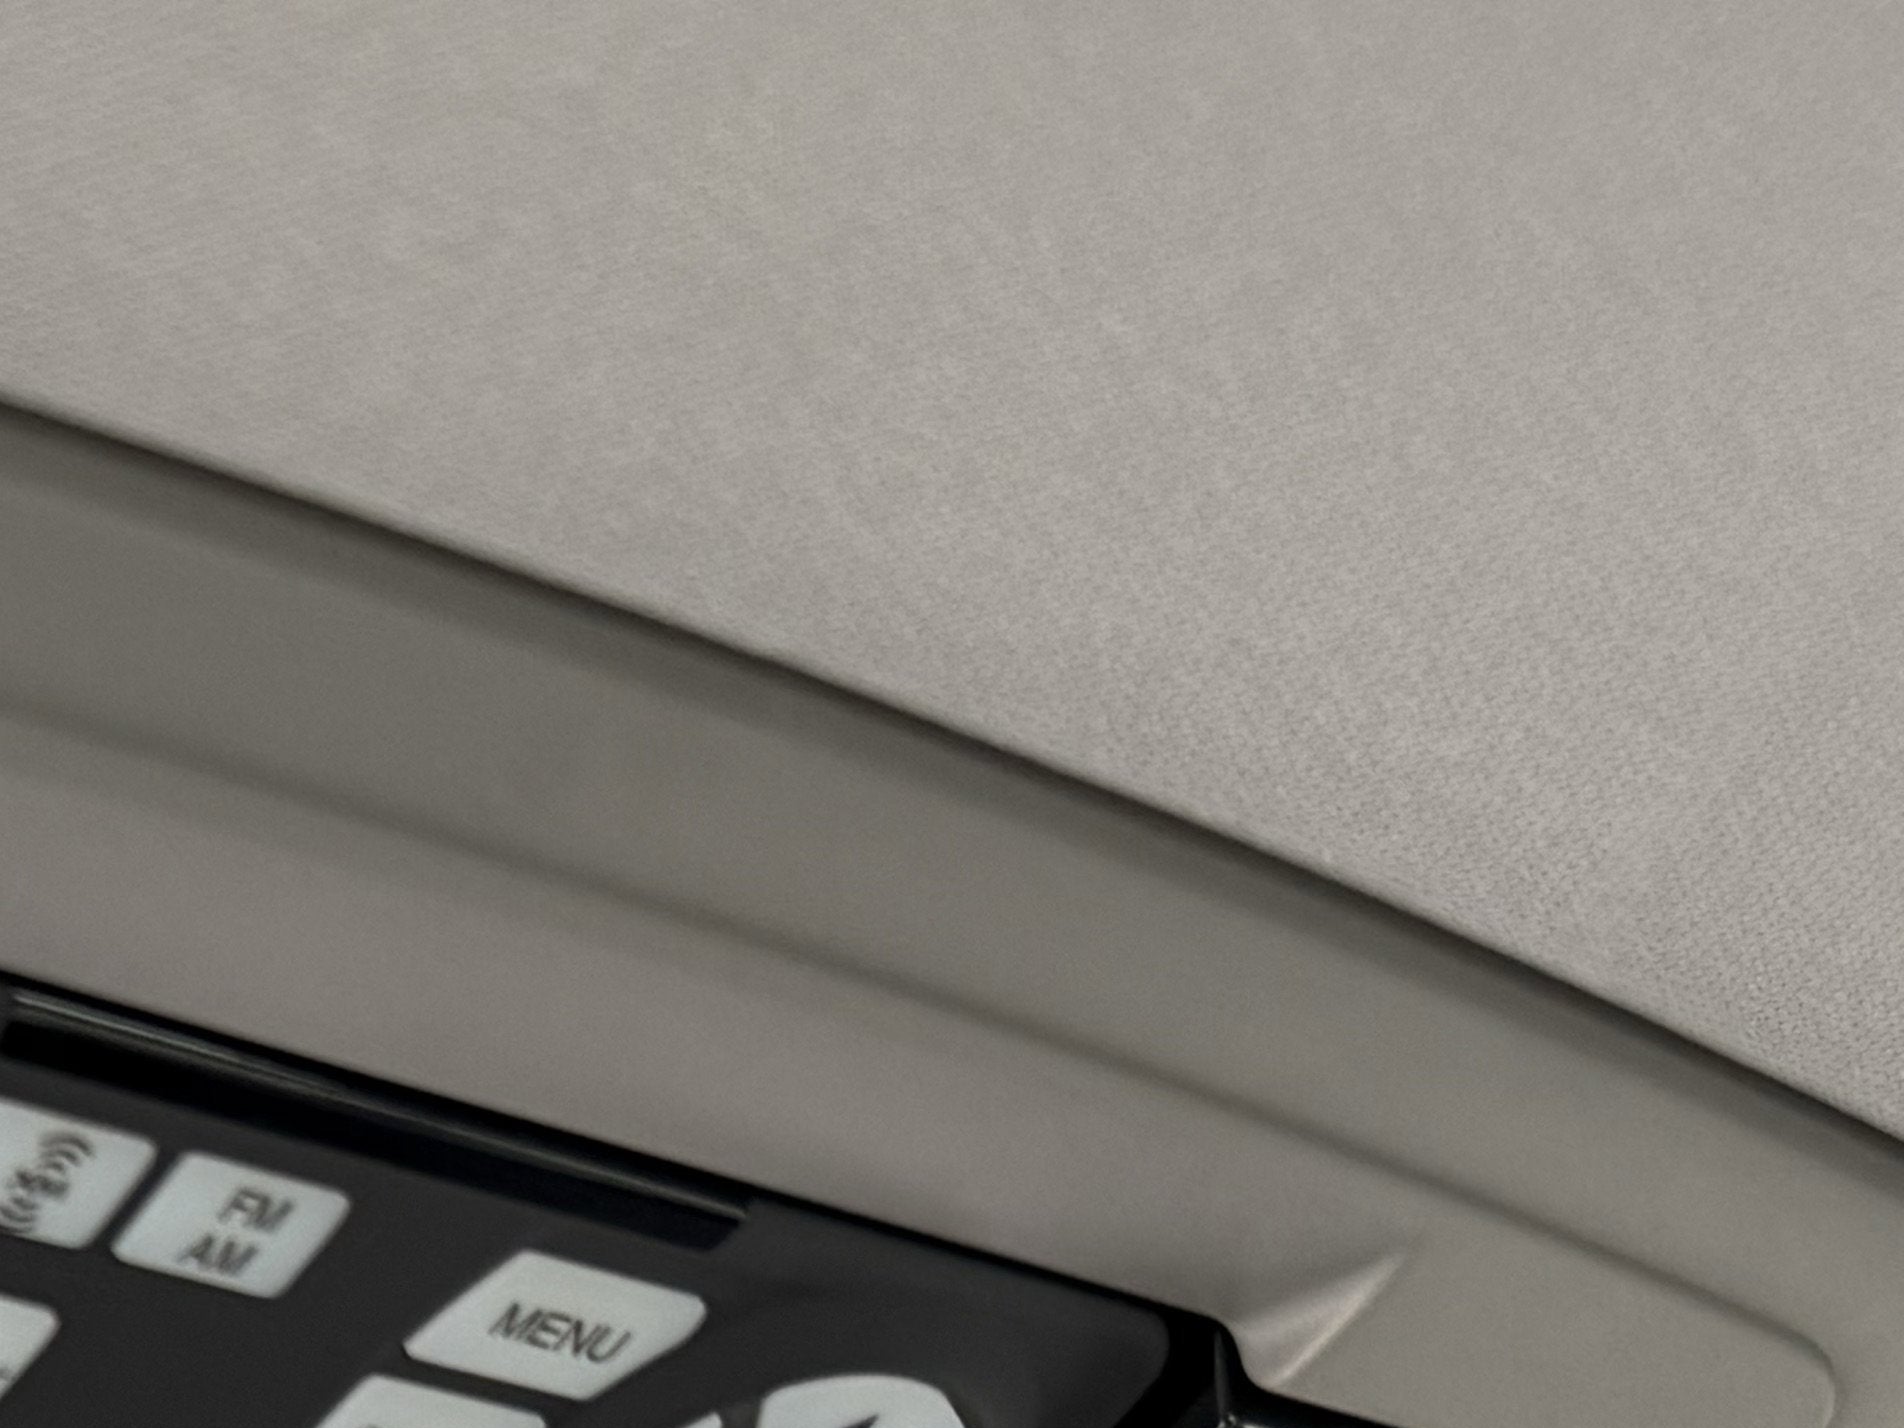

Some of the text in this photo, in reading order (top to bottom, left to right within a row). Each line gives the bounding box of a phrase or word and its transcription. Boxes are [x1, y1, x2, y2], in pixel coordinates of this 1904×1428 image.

[219, 1184, 296, 1234] FM
[178, 1230, 259, 1277] AM
[486, 1302, 638, 1364] MENU
